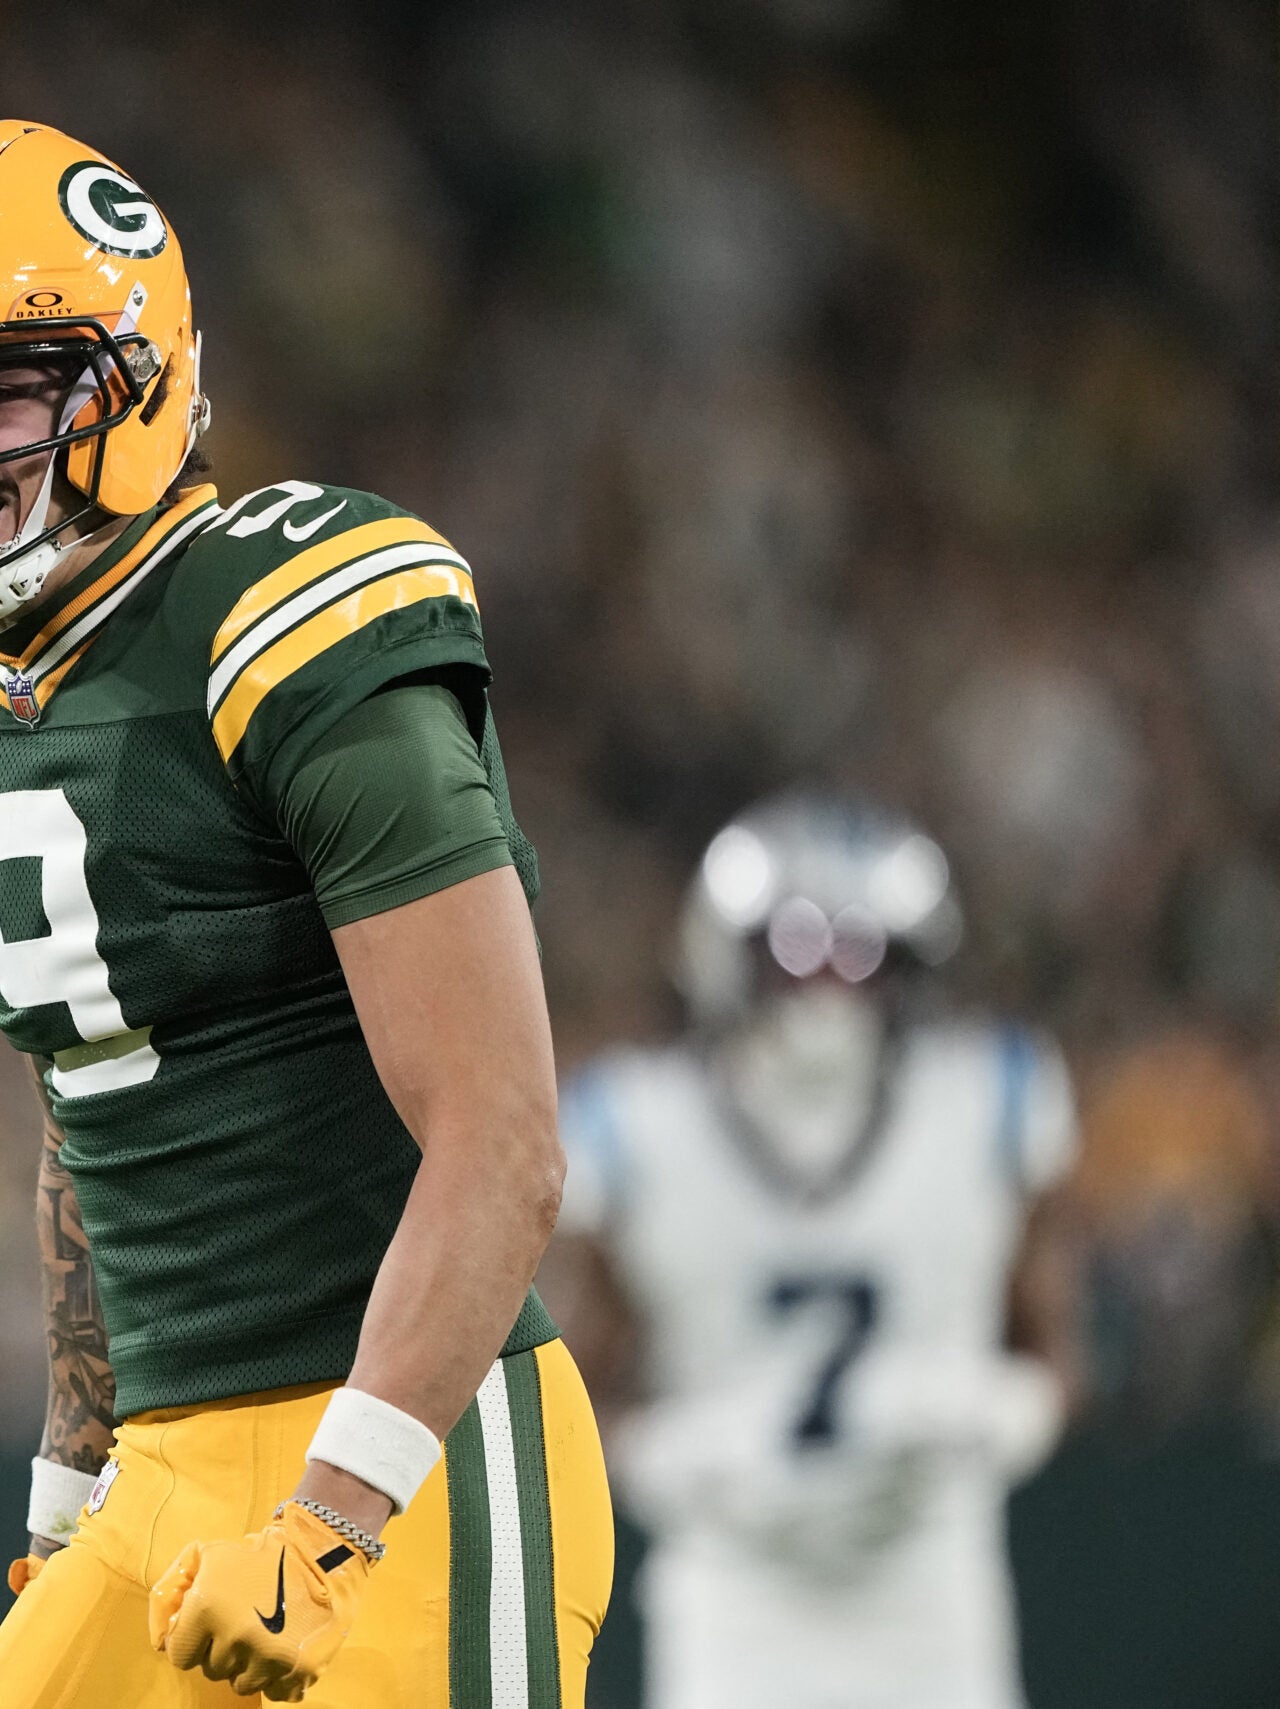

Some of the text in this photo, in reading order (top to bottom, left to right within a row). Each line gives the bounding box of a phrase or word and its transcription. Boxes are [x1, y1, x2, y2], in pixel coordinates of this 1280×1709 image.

[65, 166, 167, 251] G
[16, 308, 73, 318] OAKLEY
[766, 1268, 878, 1450] 7
